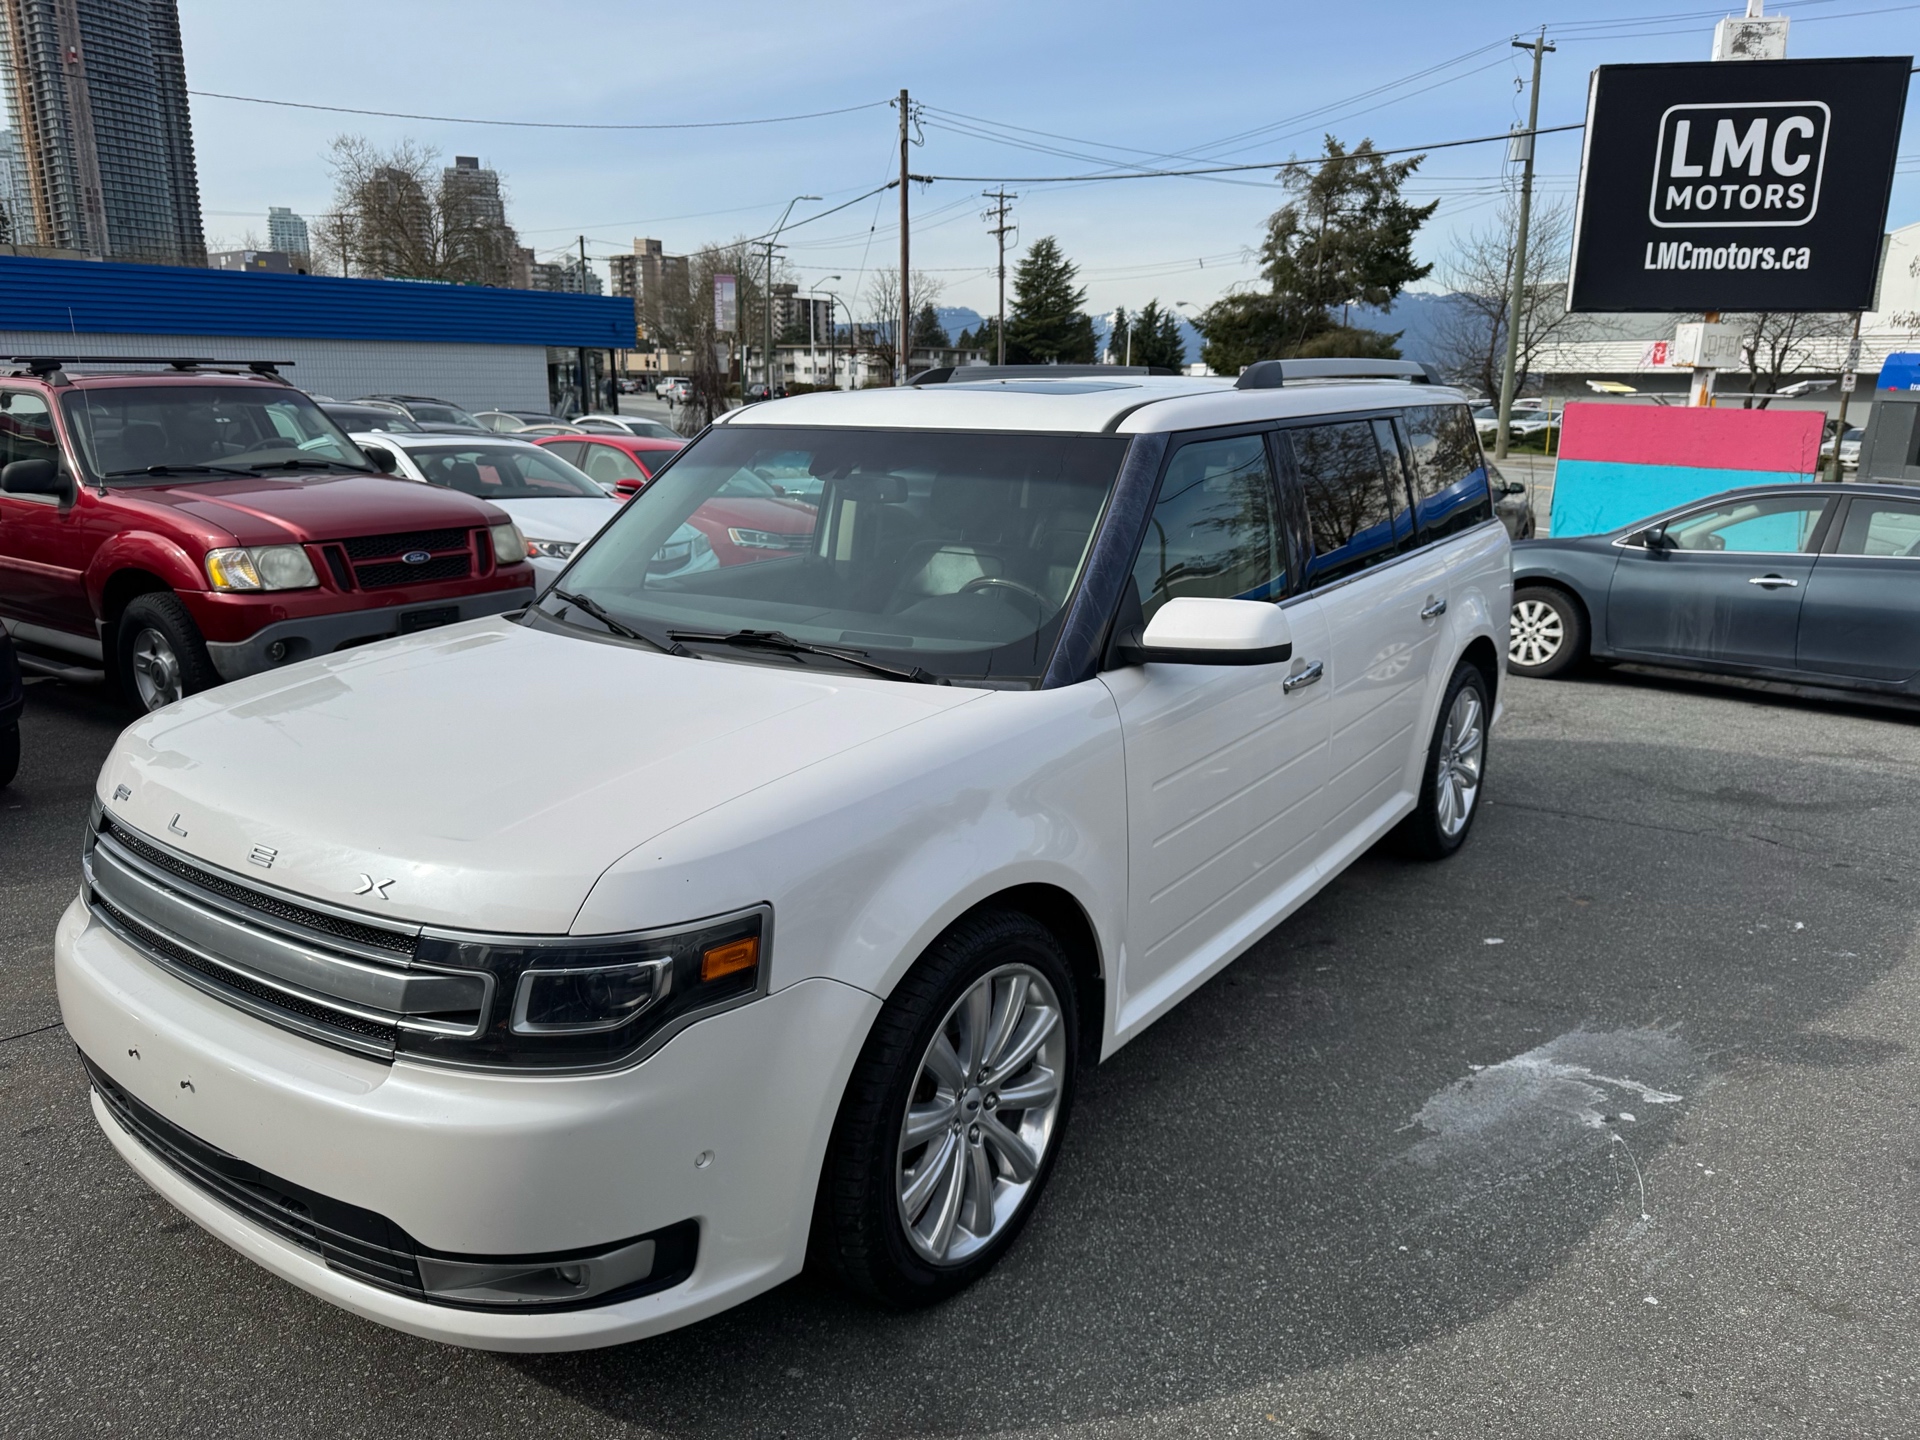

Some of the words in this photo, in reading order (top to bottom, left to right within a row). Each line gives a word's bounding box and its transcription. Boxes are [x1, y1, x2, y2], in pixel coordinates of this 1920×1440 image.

[1670, 116, 1815, 178] LMC
[1665, 183, 1807, 211] MOTORS
[1644, 241, 1811, 270] LMCmotors.ca
[112, 783, 397, 900] FLEX
